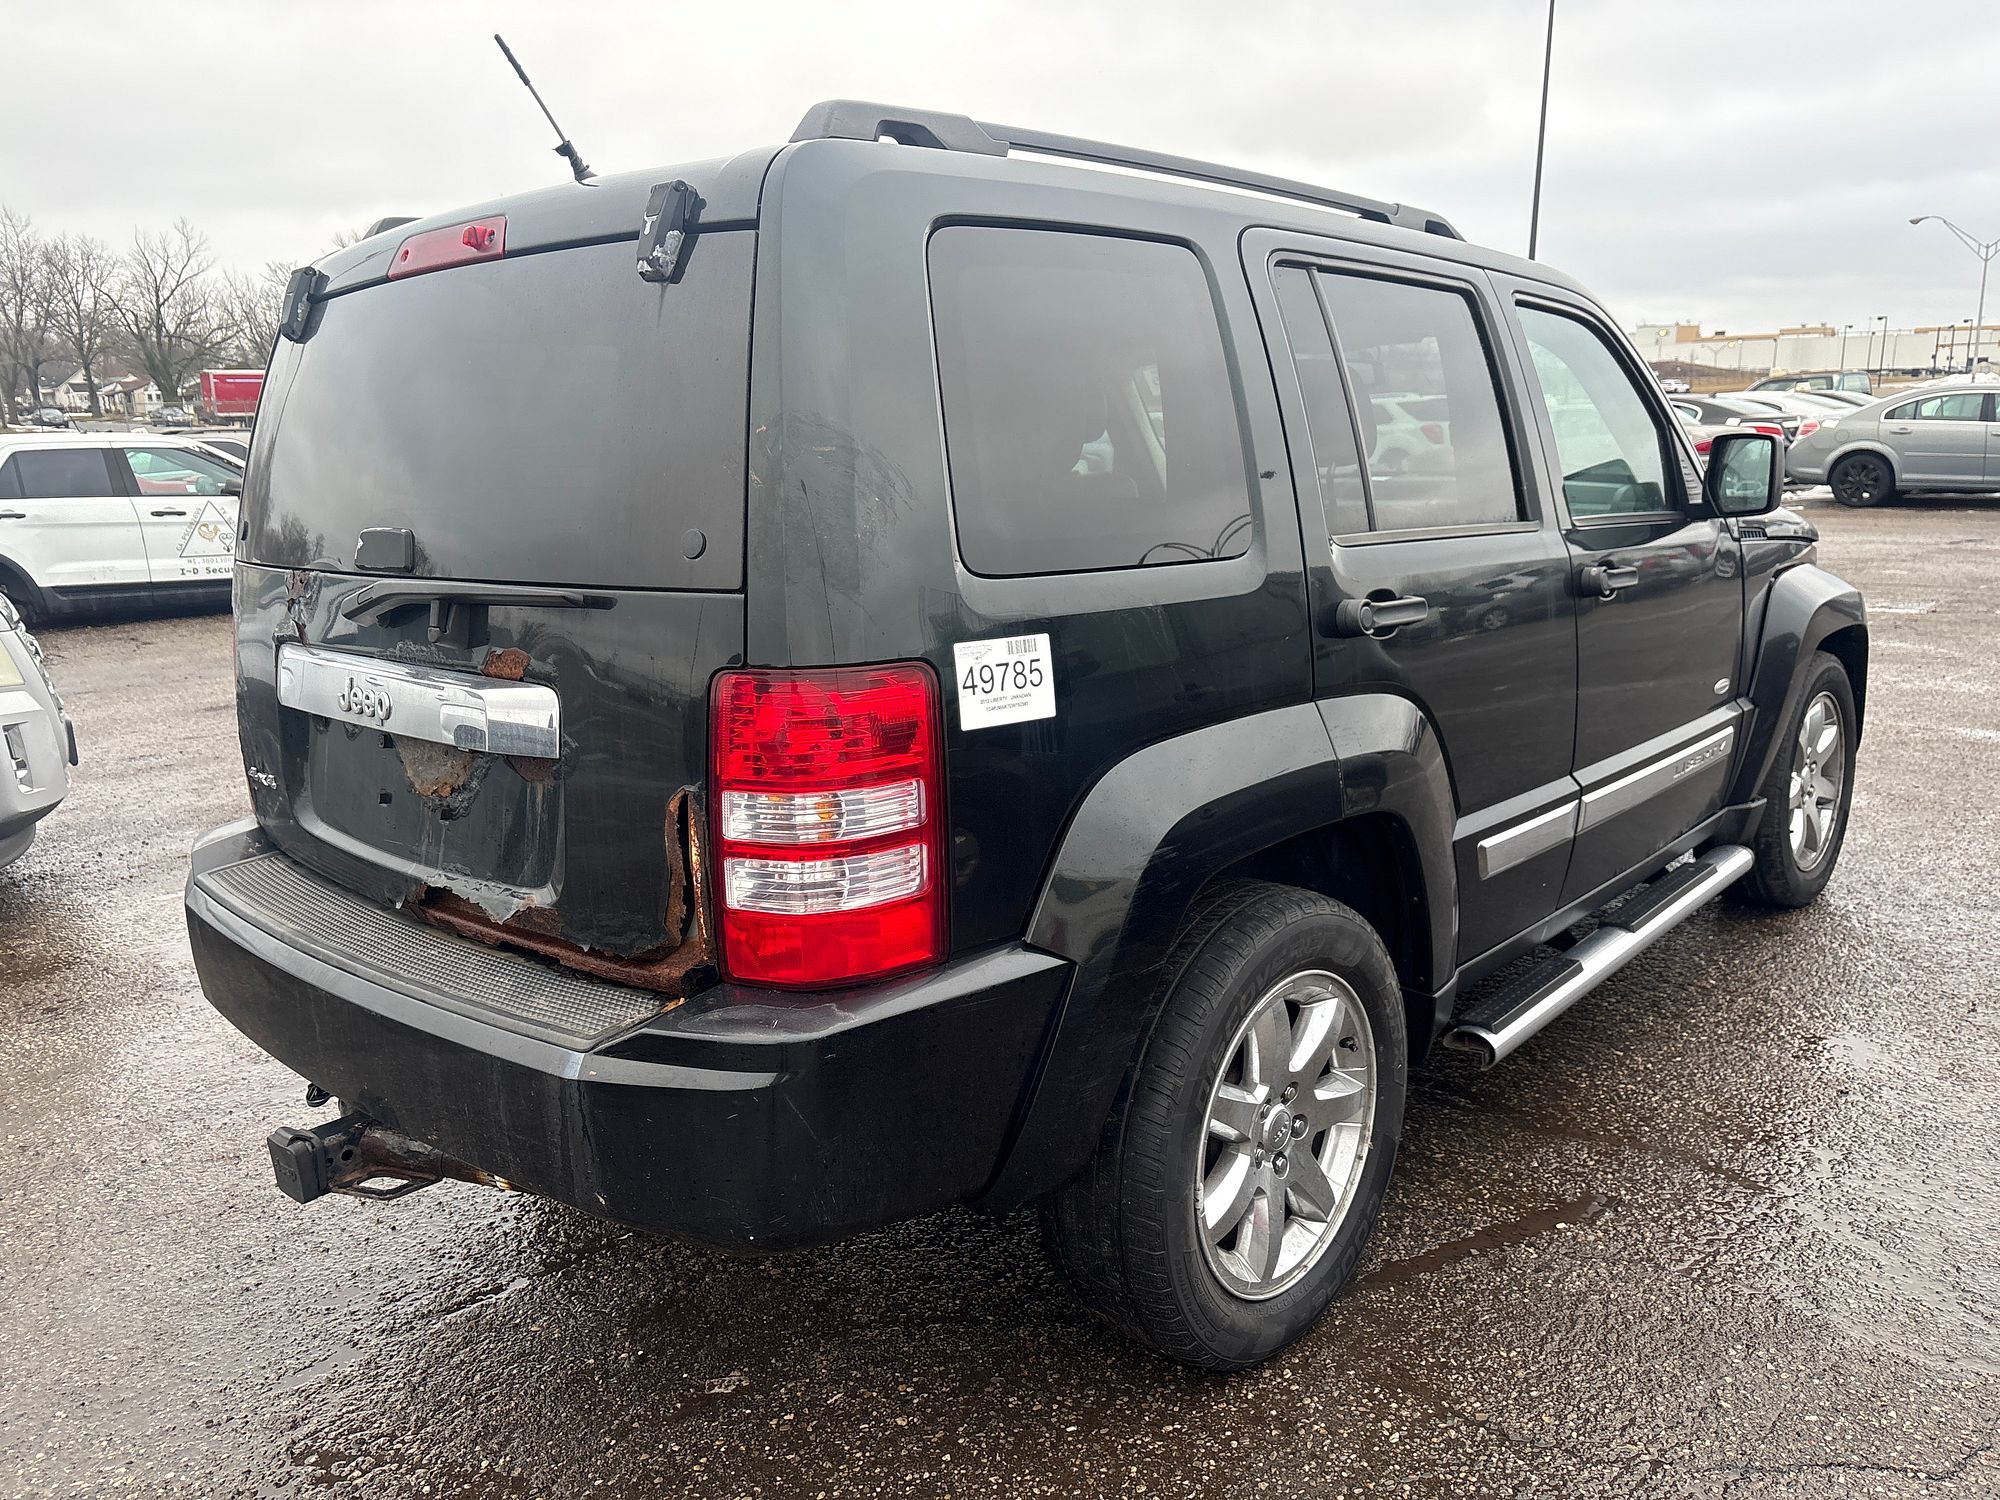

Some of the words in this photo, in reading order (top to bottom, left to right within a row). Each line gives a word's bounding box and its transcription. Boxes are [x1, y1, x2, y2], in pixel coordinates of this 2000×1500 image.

[180, 568, 199, 576] I-D
[962, 658, 1043, 695] 49785
[337, 676, 392, 727] Jeep
